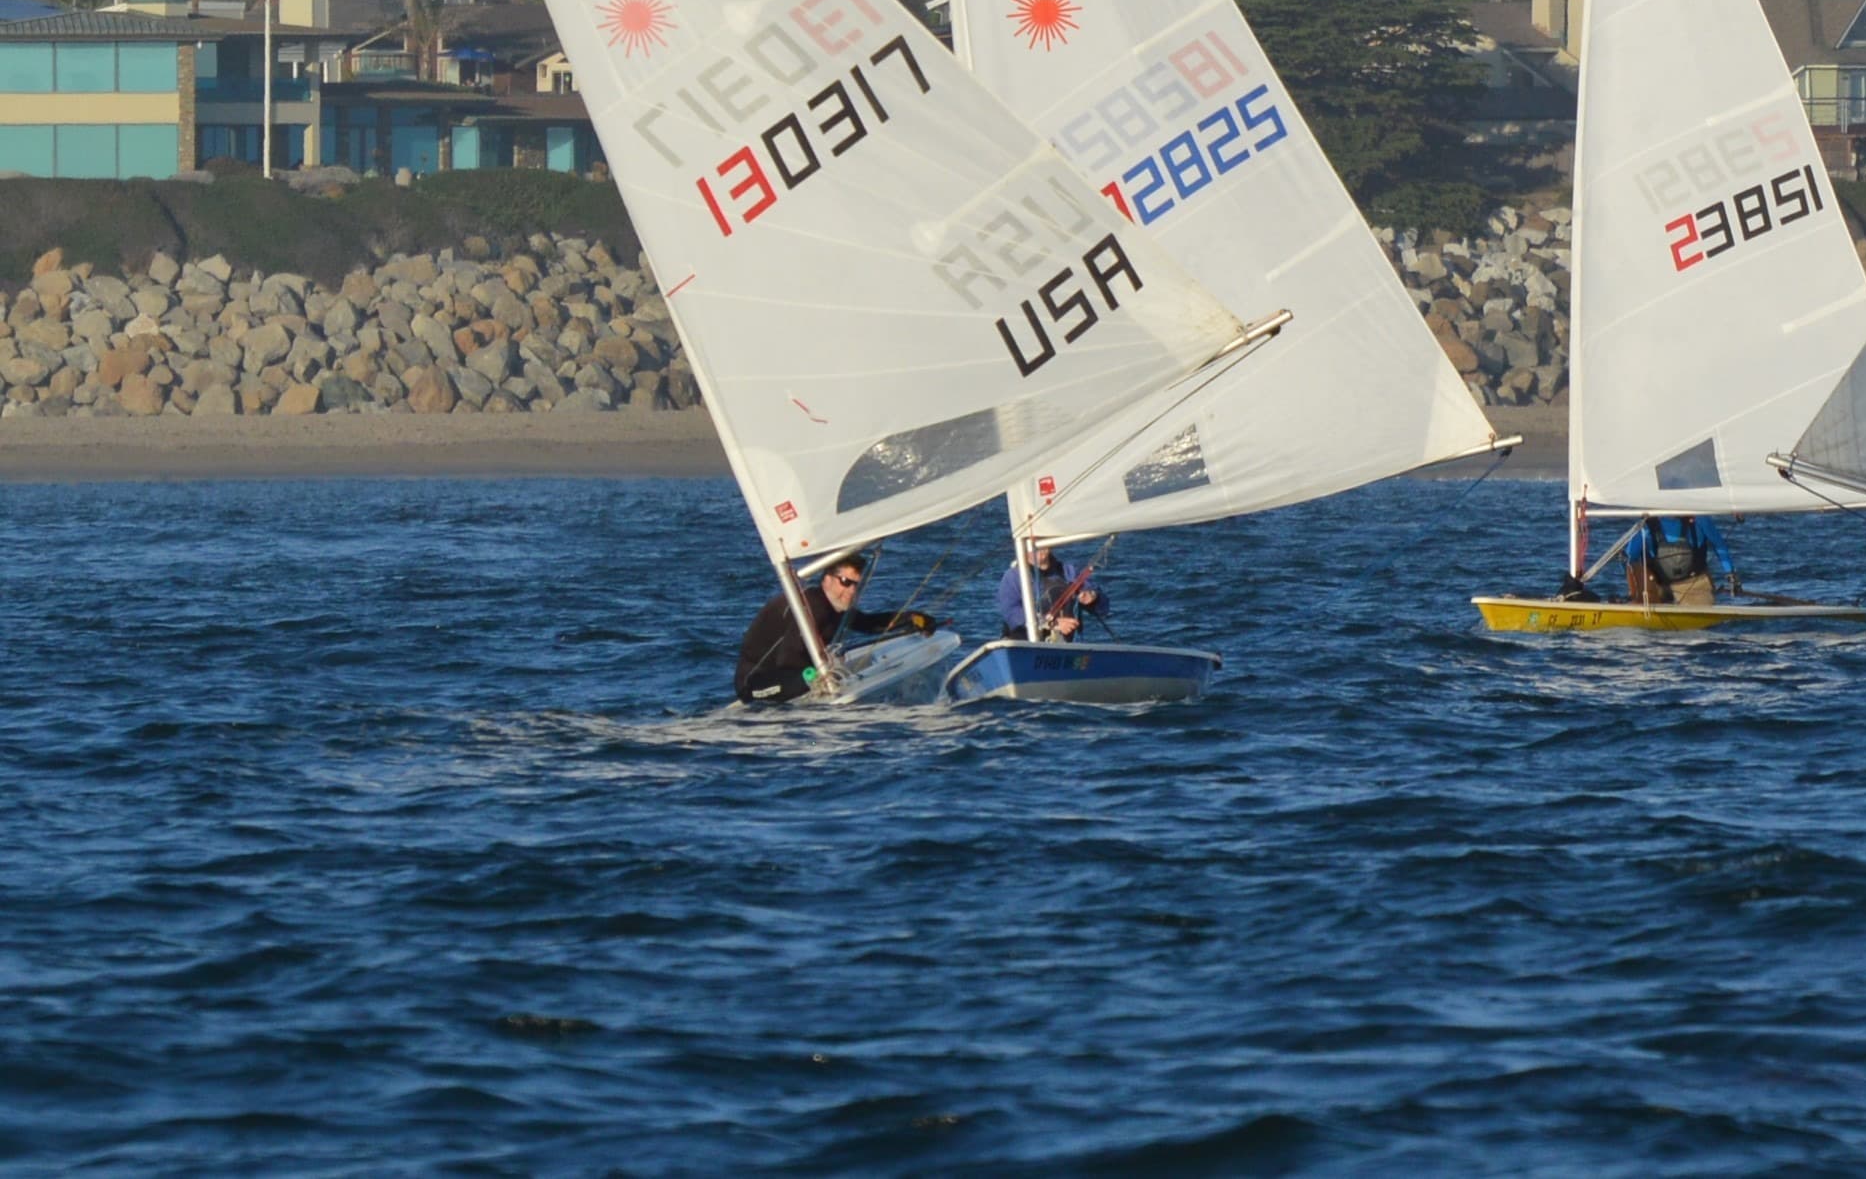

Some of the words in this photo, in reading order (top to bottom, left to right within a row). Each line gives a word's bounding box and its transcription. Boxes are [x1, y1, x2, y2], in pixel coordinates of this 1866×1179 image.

[695, 34, 931, 237] 130317
[1665, 164, 1824, 272] 23851
[995, 233, 1143, 377] USA
